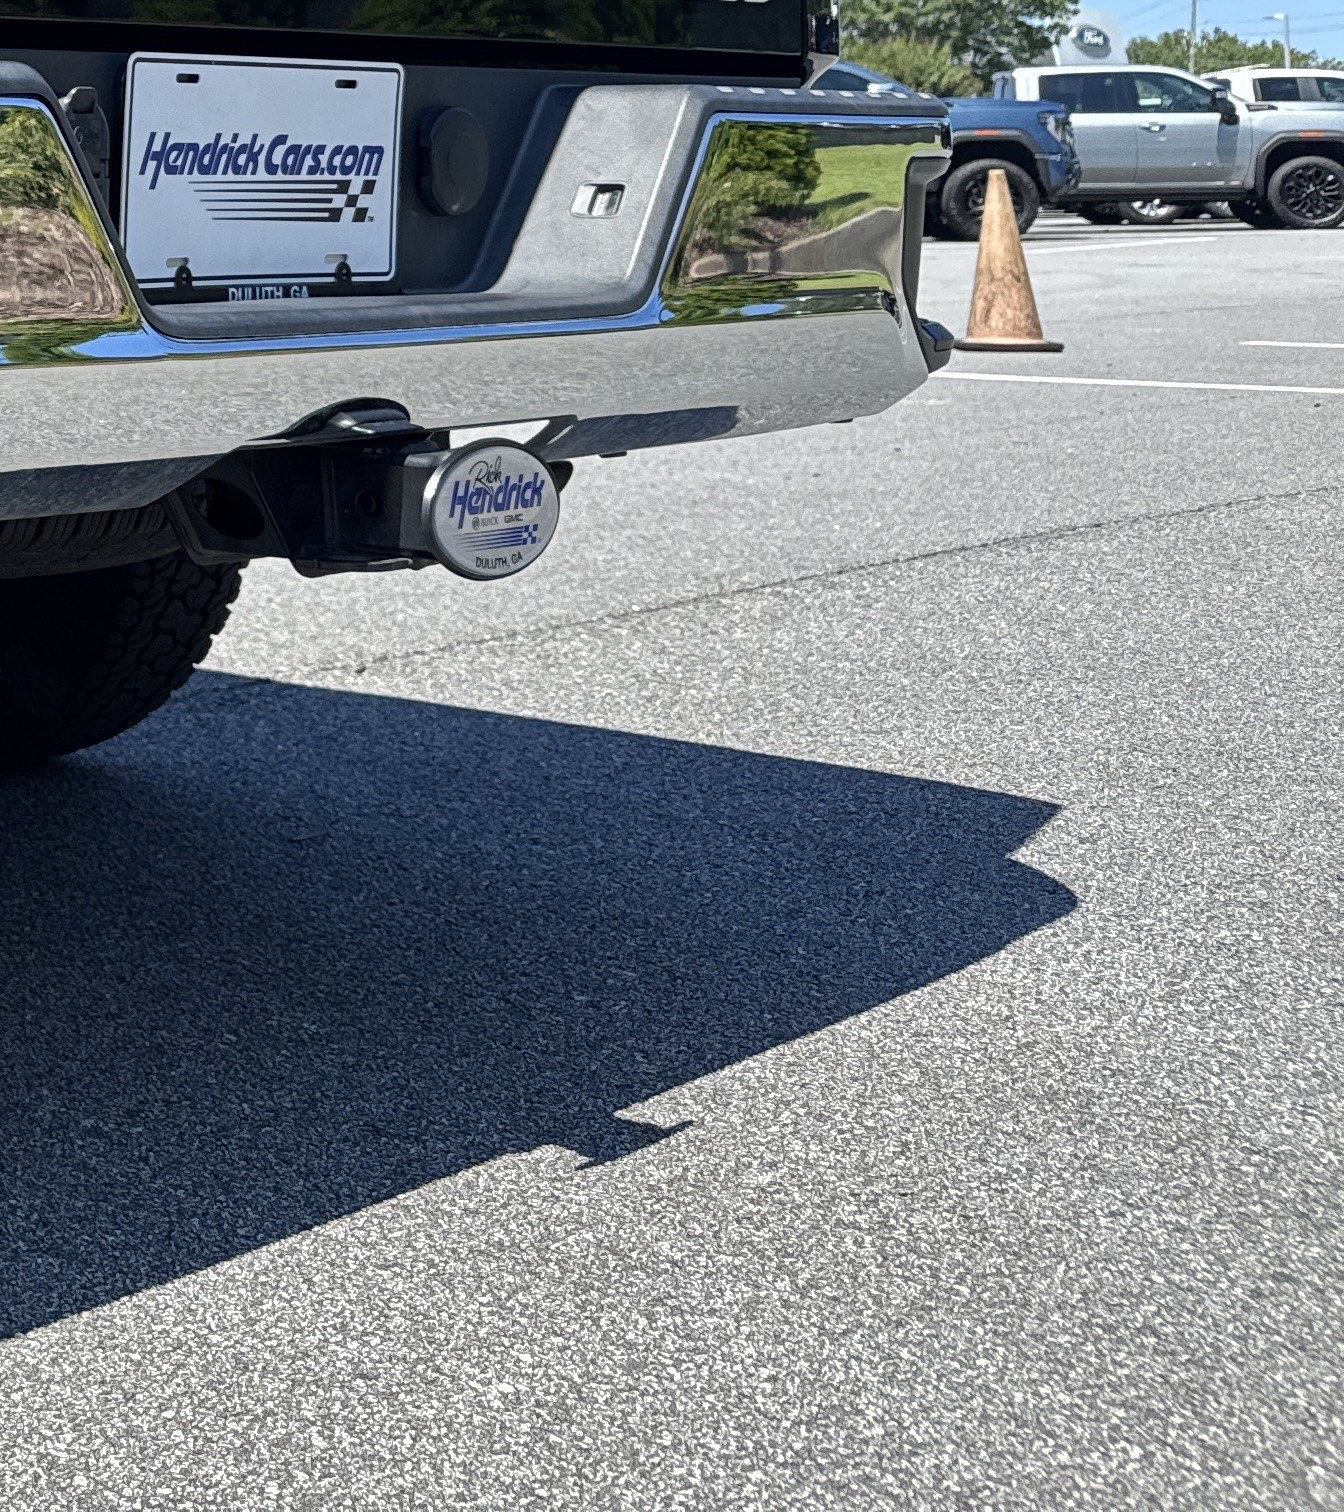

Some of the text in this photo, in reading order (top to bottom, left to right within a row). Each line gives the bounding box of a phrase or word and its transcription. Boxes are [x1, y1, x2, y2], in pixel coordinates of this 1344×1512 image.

[468, 455, 503, 494] Rick
[448, 471, 546, 530] Hendrick
[511, 551, 523, 564] GA
